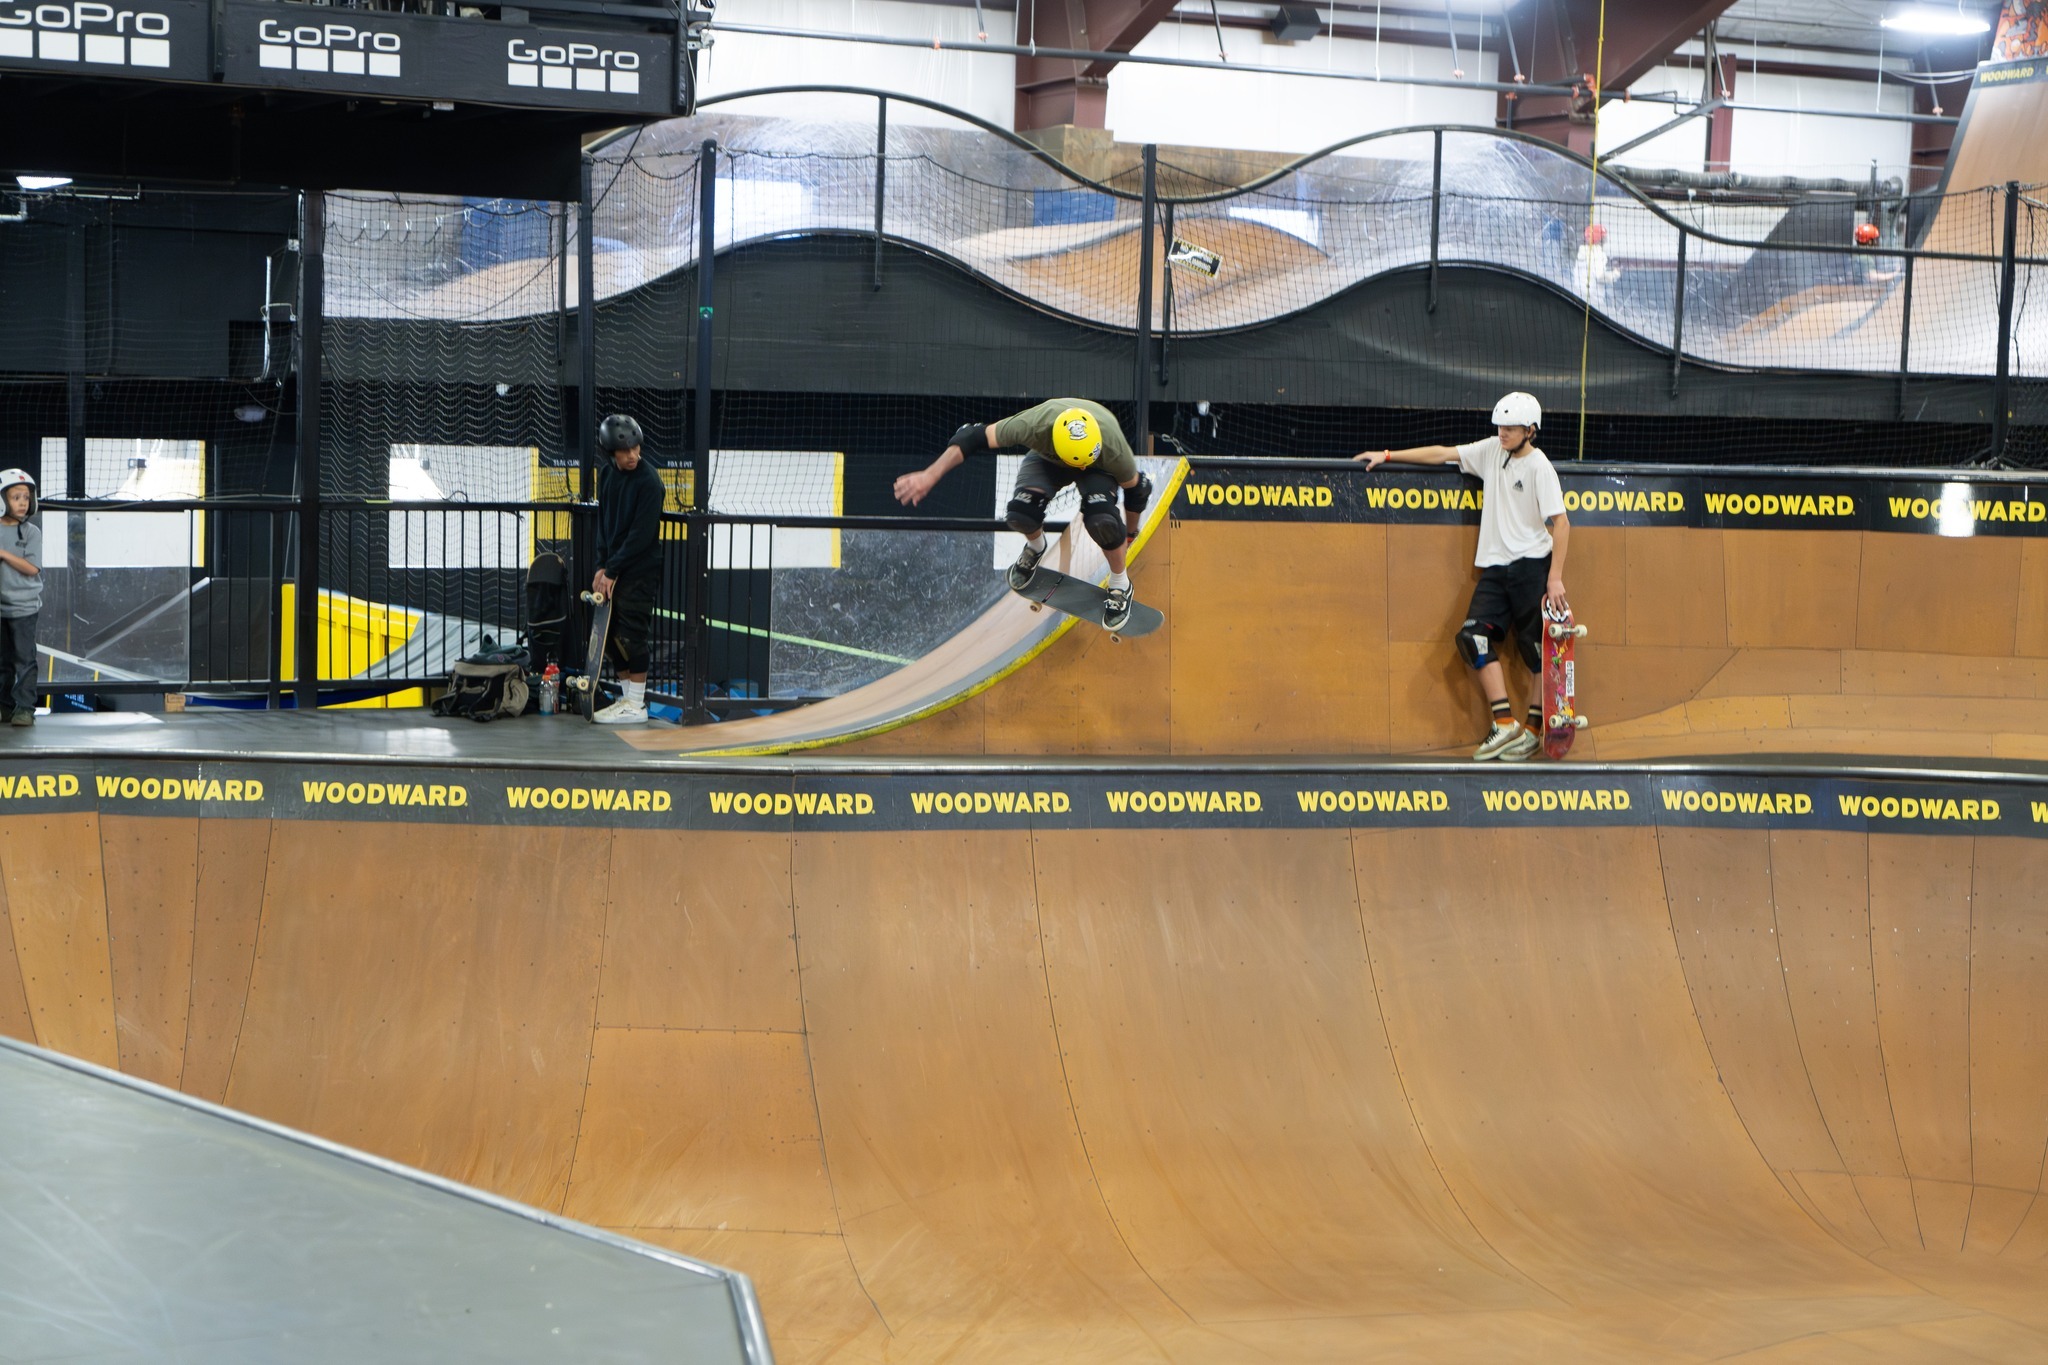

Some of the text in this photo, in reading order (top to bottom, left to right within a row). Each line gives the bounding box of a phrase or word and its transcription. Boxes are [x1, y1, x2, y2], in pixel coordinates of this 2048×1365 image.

[0, 0, 170, 36] GoPro
[259, 19, 401, 52] GoPro
[507, 38, 640, 70] GoPro
[1980, 67, 2034, 83] WOODWARD
[1185, 483, 1333, 507] WOODWARD
[1561, 491, 1684, 512] OODWARD
[1704, 493, 1854, 516] WOODWARD
[1888, 497, 2047, 522] WOOWARD
[95, 775, 263, 801] WOODWARD
[303, 781, 467, 807] WOODWARD
[507, 786, 671, 811] WOODWARD
[709, 791, 873, 816] WOODWARD
[912, 791, 1070, 813] WOODWARD
[1107, 791, 1261, 813] WOODWARD
[1298, 790, 1447, 811] WOODWARD
[1483, 790, 1629, 811] WOODWARD
[1663, 791, 1811, 814] WOODWARD
[1839, 795, 2000, 821] WOODWARD
